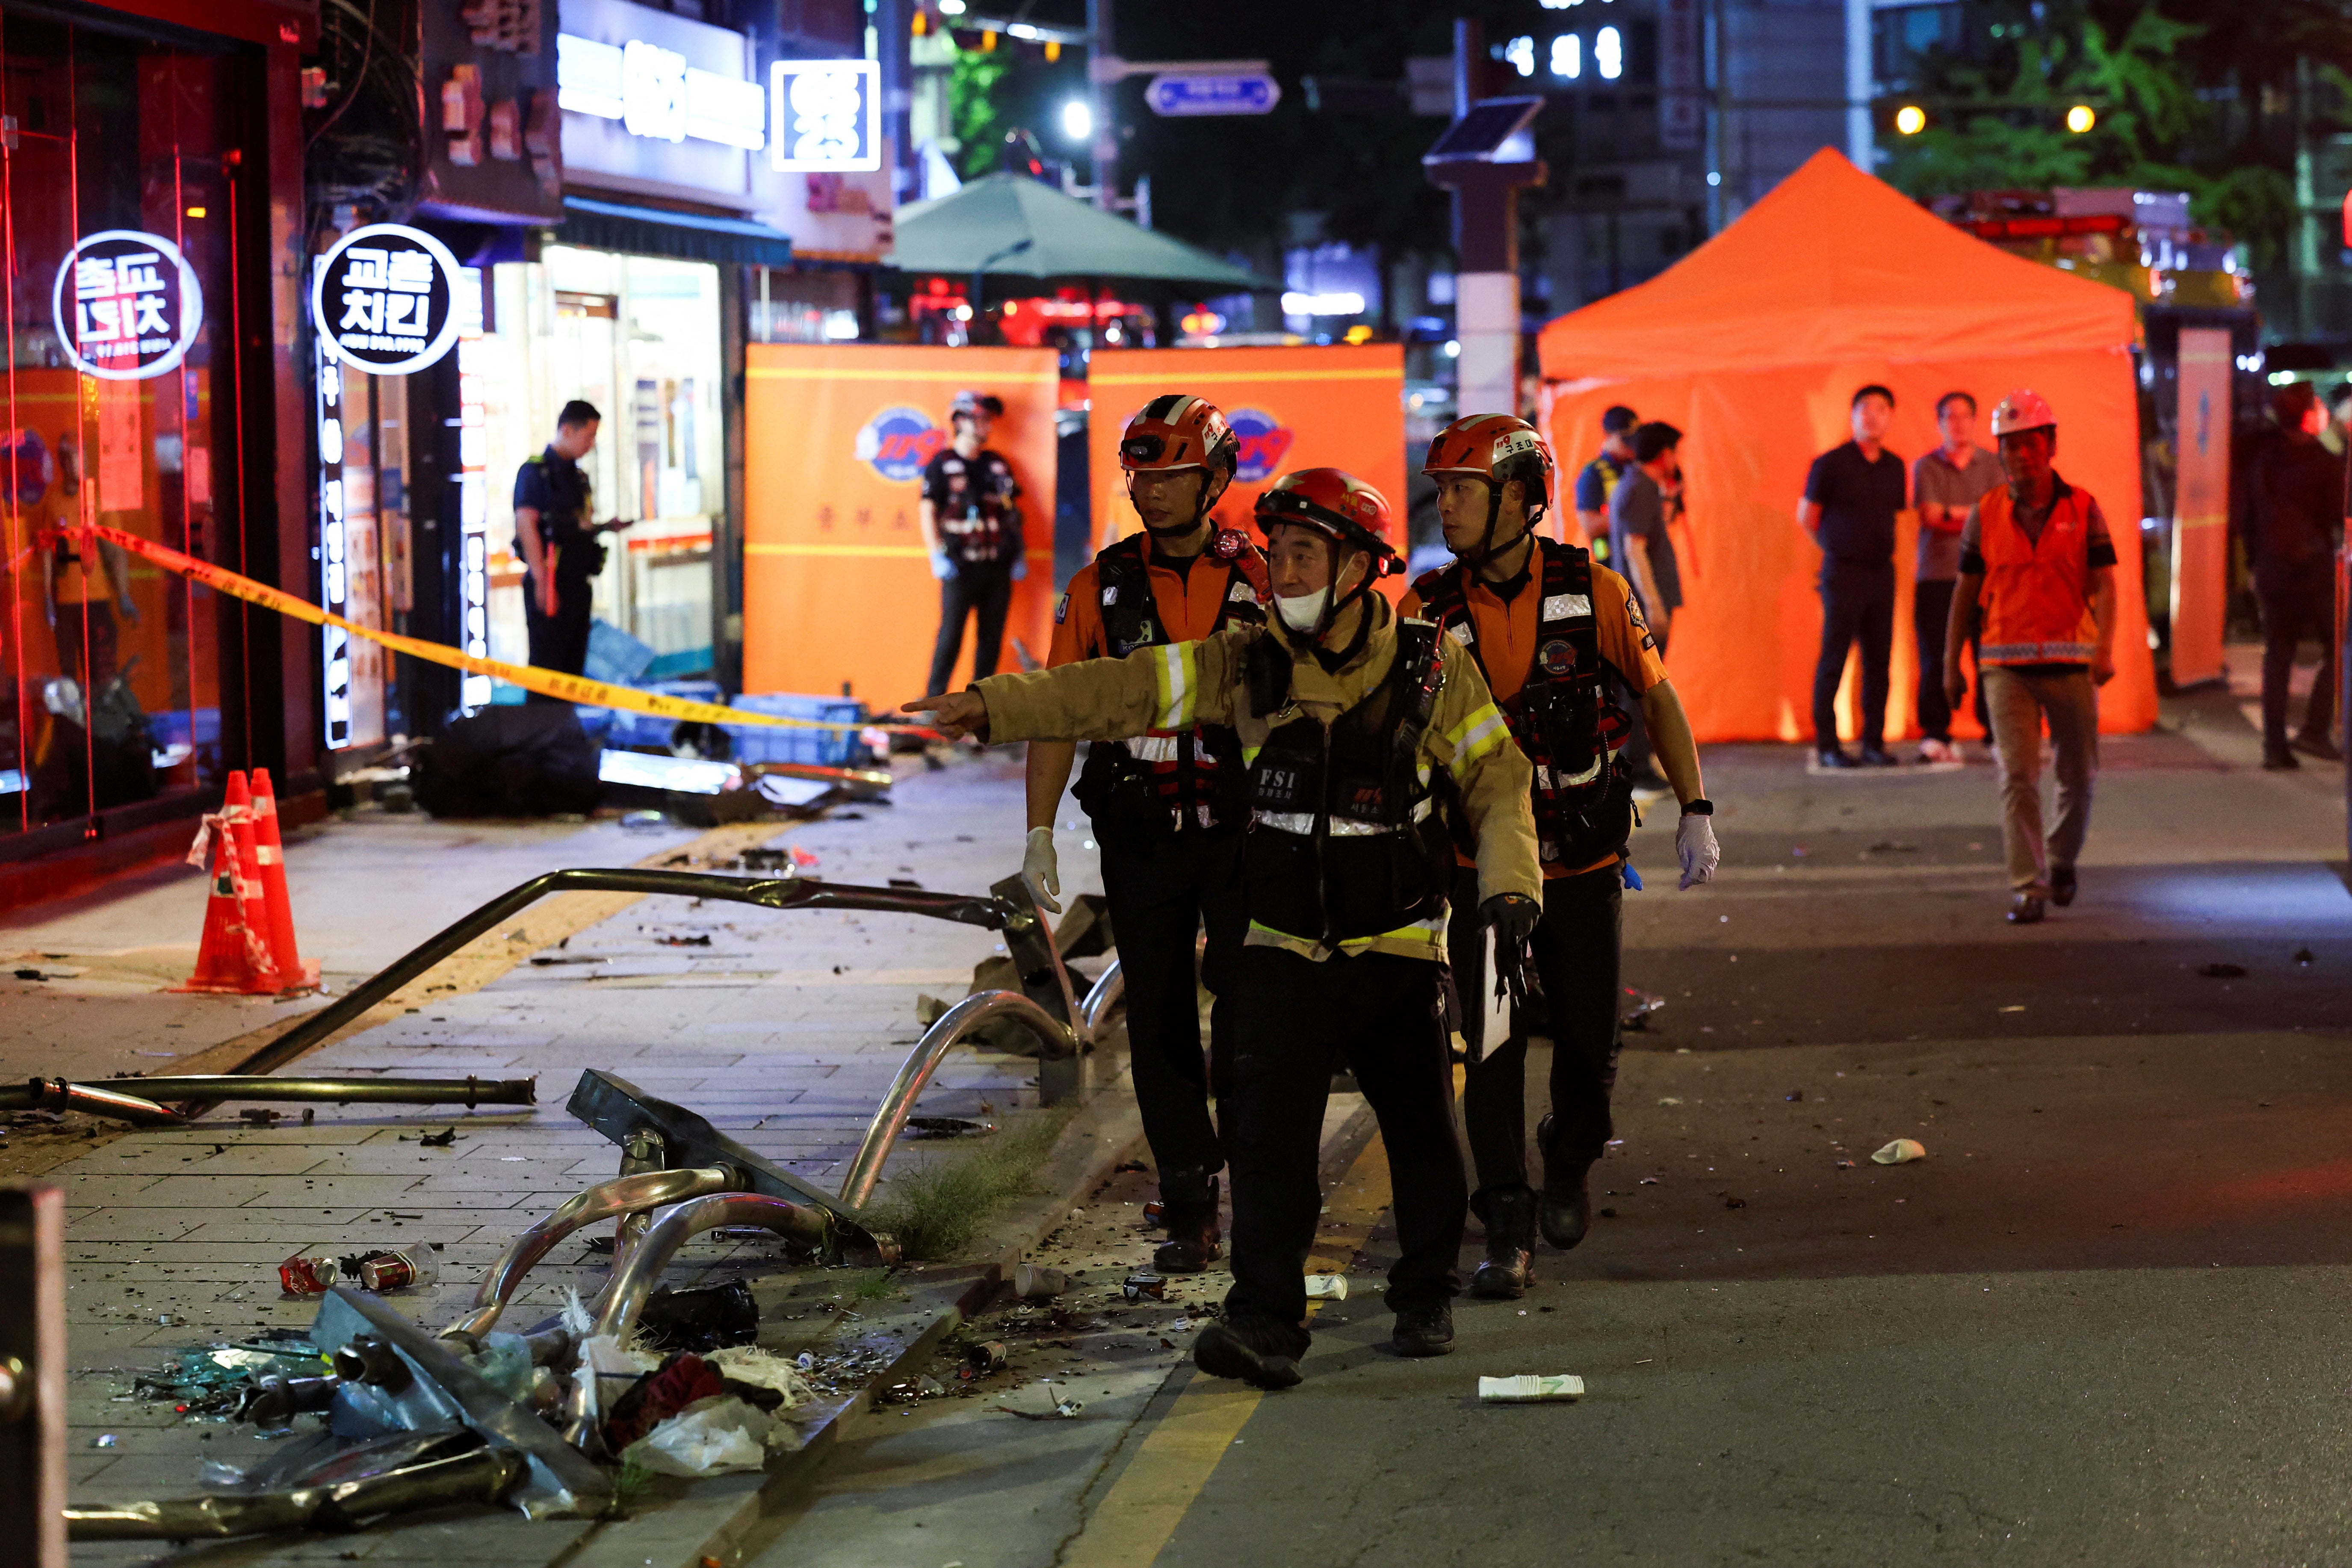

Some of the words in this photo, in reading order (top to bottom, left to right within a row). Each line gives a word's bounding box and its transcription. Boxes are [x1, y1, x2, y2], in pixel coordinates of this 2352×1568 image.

[342, 247, 434, 294] 교촌
[340, 289, 430, 337] 치킨
[1496, 435, 1510, 449] 119
[1505, 439, 1533, 454] 구조대
[1259, 769, 1295, 788] FSI
